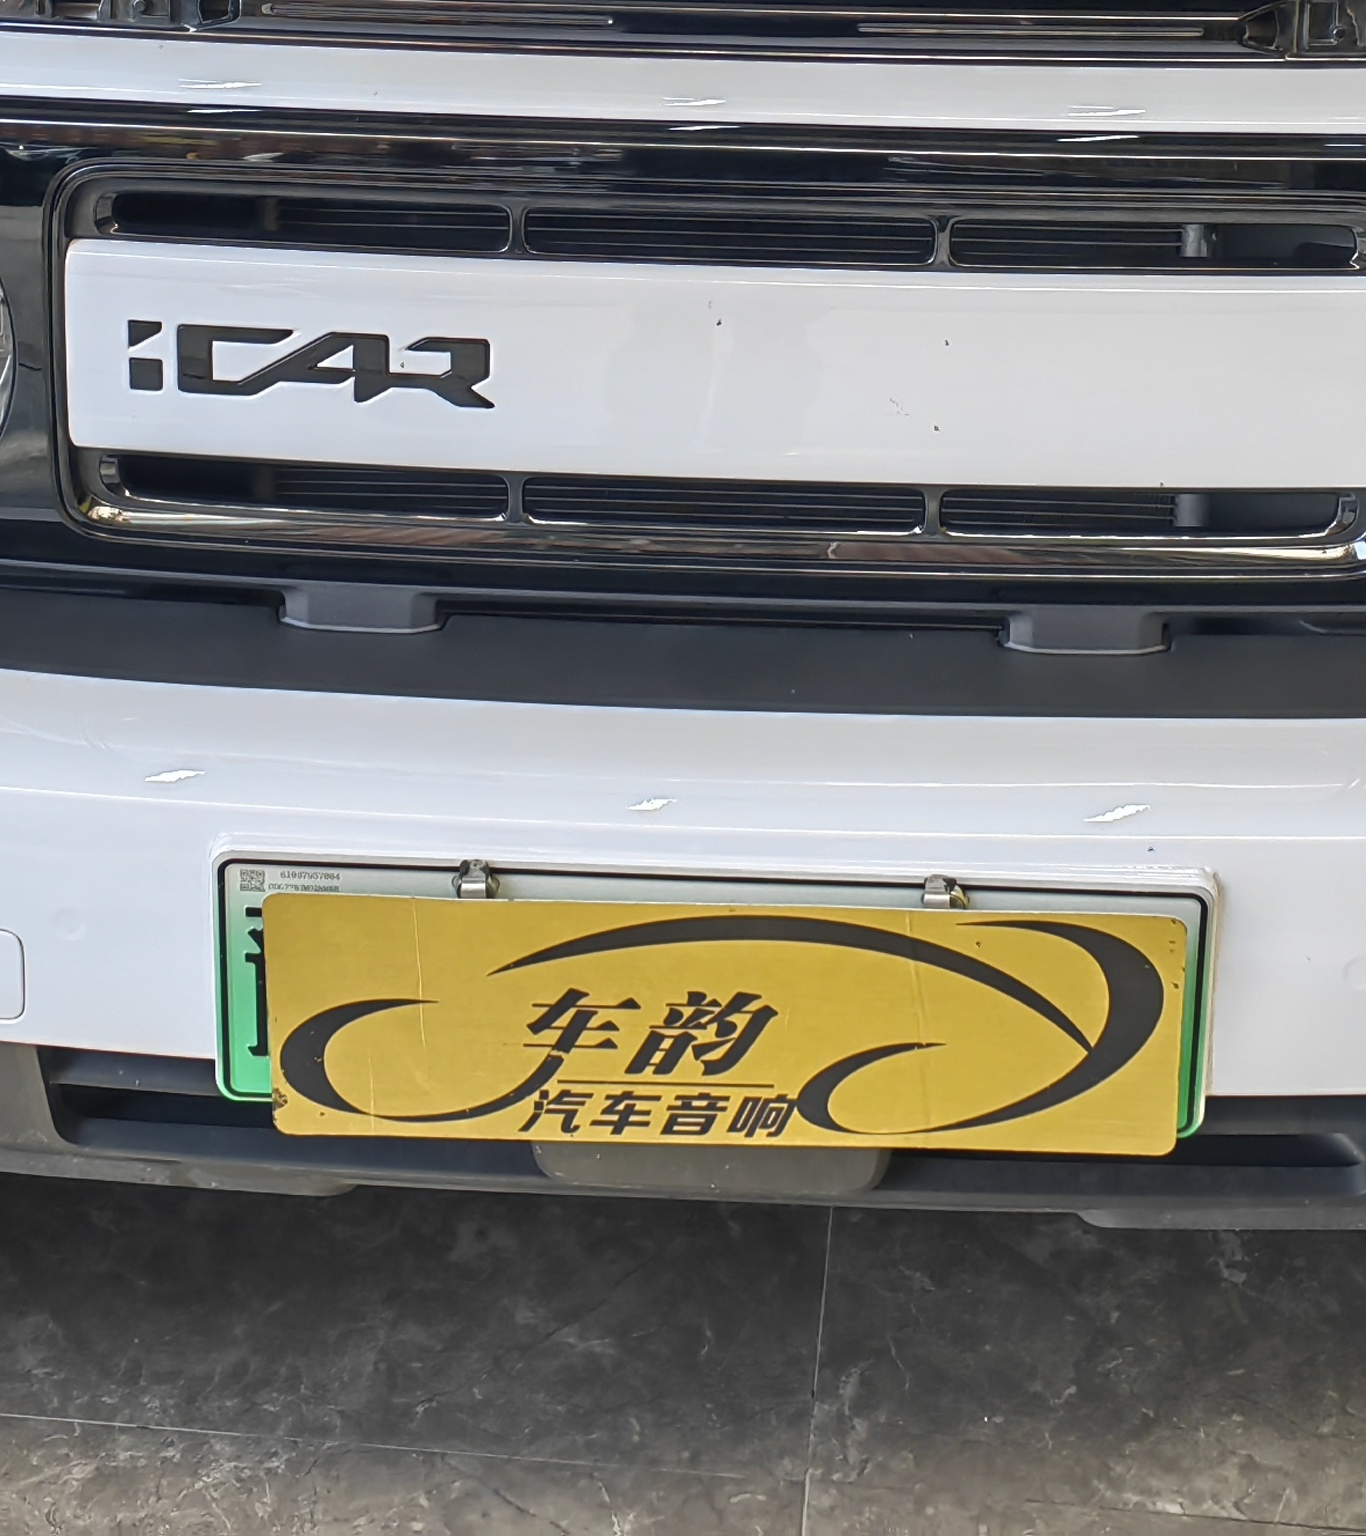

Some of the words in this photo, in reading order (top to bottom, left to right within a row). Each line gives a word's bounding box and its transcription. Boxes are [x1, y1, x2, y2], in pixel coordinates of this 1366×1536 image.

[523, 988, 779, 1076] 车韵
[517, 1089, 797, 1139] 汽车音响
